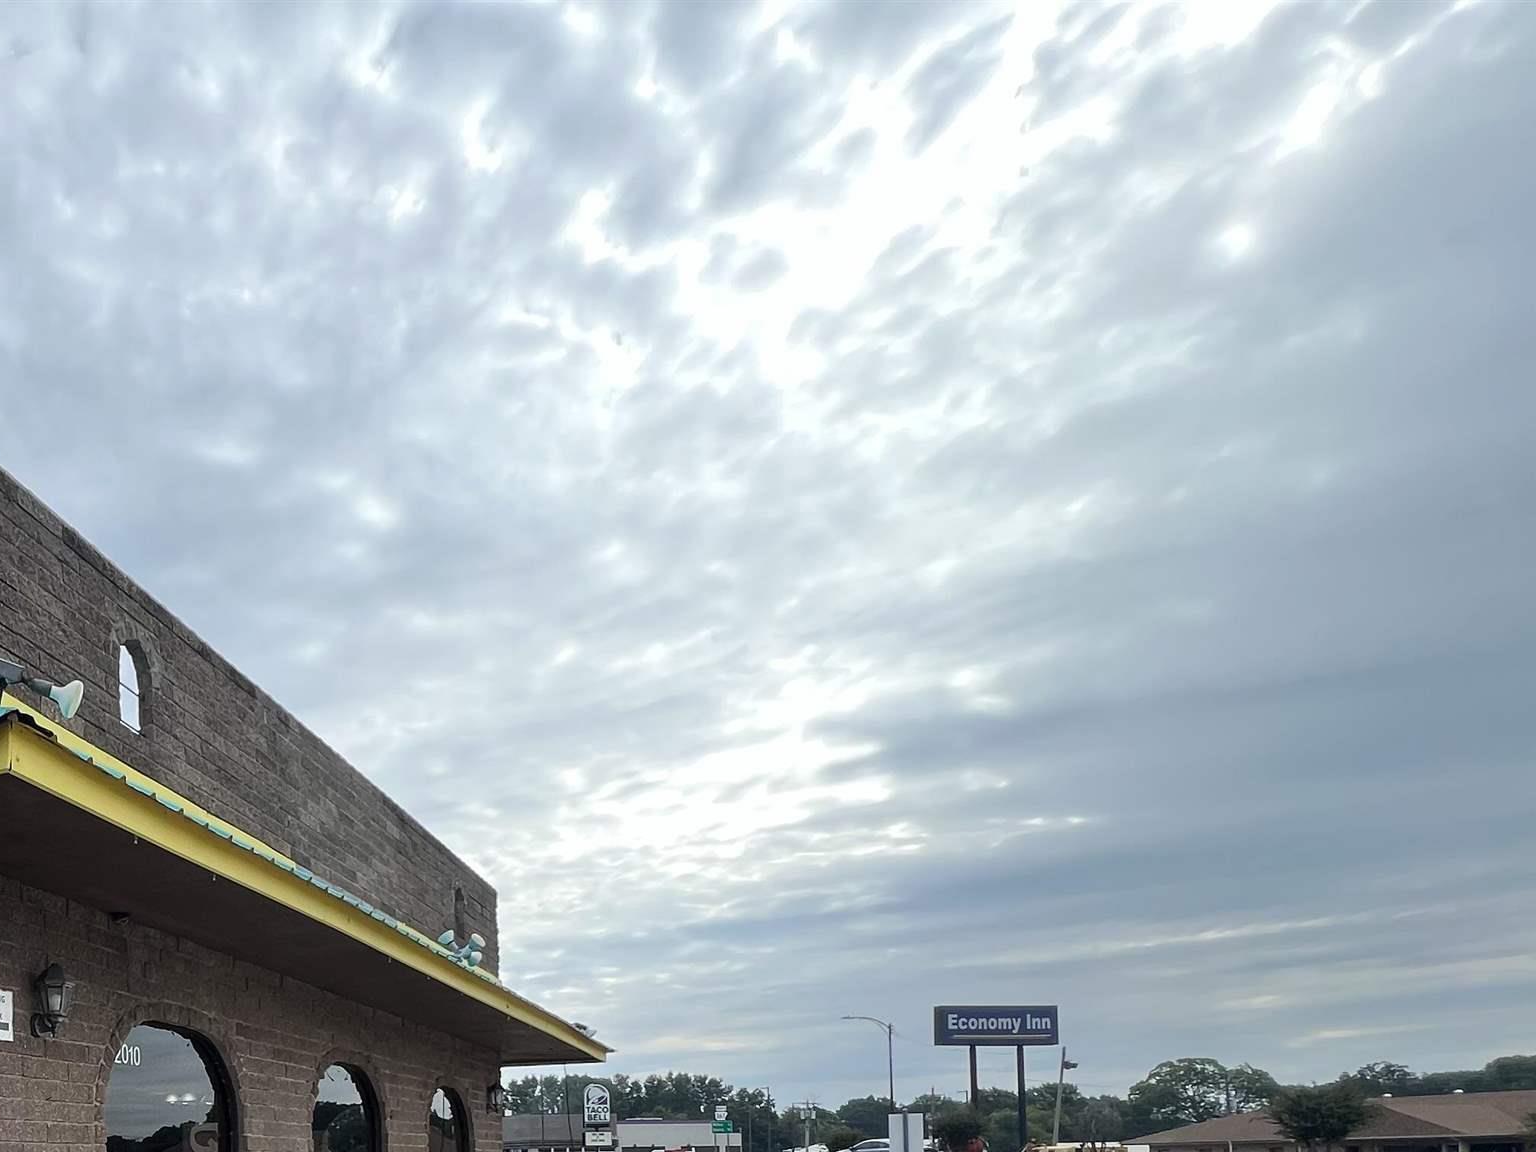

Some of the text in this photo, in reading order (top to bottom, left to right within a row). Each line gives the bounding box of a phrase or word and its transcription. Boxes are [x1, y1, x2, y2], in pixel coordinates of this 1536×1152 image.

[947, 1013, 1052, 1034] Economy Inn
[585, 1106, 609, 1114] TACO
